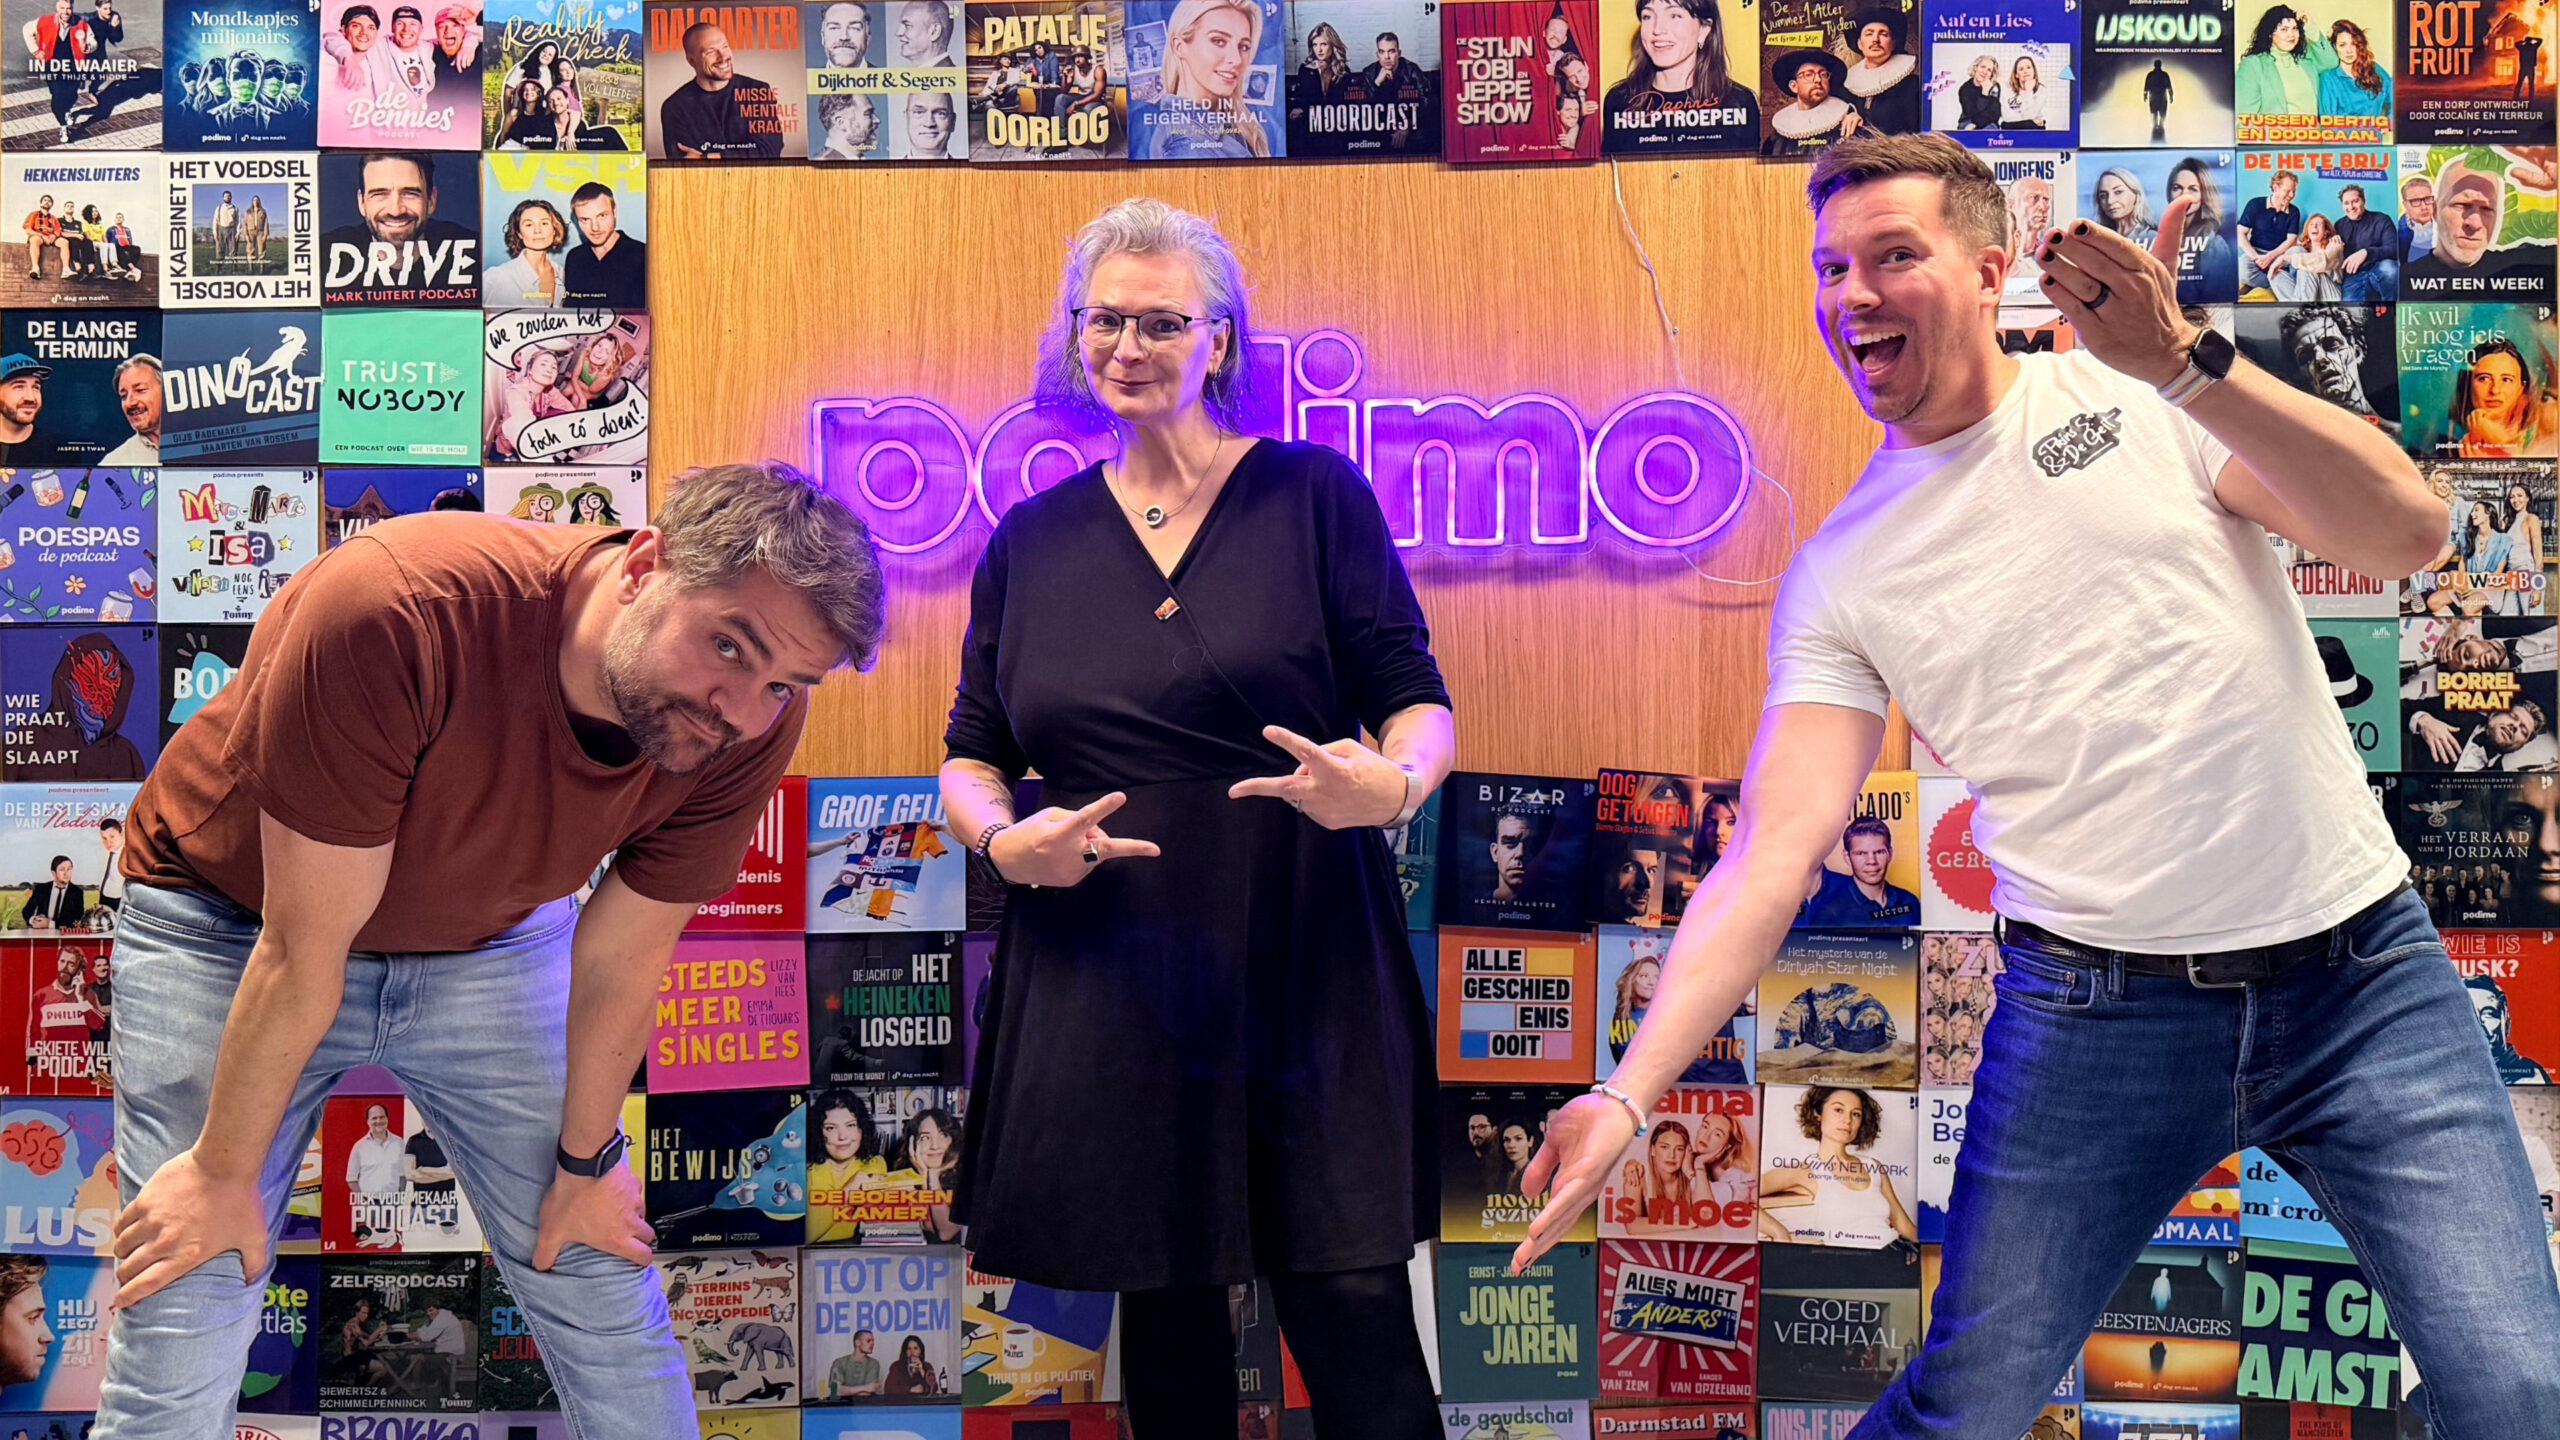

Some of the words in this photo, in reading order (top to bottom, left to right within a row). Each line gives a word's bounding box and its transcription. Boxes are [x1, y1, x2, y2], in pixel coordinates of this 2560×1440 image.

[191, 11, 299, 29] Mondkapjes
[503, 2, 606, 51] Reality
[2409, 1, 2481, 47] ROT
[201, 28, 290, 45] miljonairs
[984, 14, 1107, 55] PATATJE
[1933, 30, 1975, 41] pakken
[1978, 29, 2006, 39] door
[1467, 37, 1533, 58] STIJN
[28, 59, 47, 72] IN
[50, 59, 71, 72] DE
[74, 59, 138, 72] WAAIER
[1457, 60, 1514, 81] TOBI
[2409, 48, 2475, 76] FRUIT
[818, 73, 877, 92] Dijkhoff
[882, 73, 898, 88] &
[900, 72, 956, 91] Segers
[1456, 80, 1531, 102] JEPPE
[734, 88, 778, 101] MISSIE
[740, 104, 797, 118] MENTALE
[1172, 98, 1213, 111] HELD
[1219, 98, 1233, 110] IN
[1456, 102, 1532, 124] SHOW
[2422, 101, 2440, 109] EEN
[2444, 100, 2470, 109] DORP
[2473, 100, 2530, 109] ONTWRICHT
[1144, 112, 1191, 125] EIGEN
[1196, 112, 1267, 124] VERHAAL
[1309, 103, 1419, 132] MOORDCAST
[1614, 108, 1747, 129] HULPTROEPEN
[2238, 114, 2317, 127] TUSSEN
[2320, 115, 2389, 128] DERTIG
[2409, 111, 2436, 120] DOOR
[2483, 111, 2497, 119] EN
[2500, 111, 2543, 120] TERREUR
[749, 120, 798, 134] KRACHT
[986, 105, 1109, 147] OORLOG
[202, 134, 231, 143] podimo
[1190, 141, 1223, 150] podimo
[1348, 140, 1381, 149] podimo
[170, 160, 210, 178] HET
[215, 160, 311, 178] VOEDSEL
[2244, 153, 2271, 169] DE
[2277, 152, 2334, 169] HETE
[2340, 152, 2391, 170] BRIJ
[24, 167, 140, 182] HEKKENSLUITERS
[325, 239, 476, 287] DRIVE
[2410, 278, 2447, 291] WAT
[2452, 278, 2485, 290] EEN
[2490, 277, 2544, 290] WEEK!
[326, 291, 363, 303] MARK
[366, 290, 416, 302] TUITERT
[419, 288, 477, 301] PODCAST
[27, 322, 58, 338] DE
[62, 321, 137, 338] LANGE
[35, 341, 128, 359] TERMIJN
[2401, 346, 2477, 366] vragen
[173, 433, 192, 443] GIJS
[195, 425, 247, 441] RADEMAKER
[201, 441, 242, 454] MAARTEN
[245, 438, 262, 447] VAN
[263, 432, 299, 445] ROSSEM
[19, 526, 140, 547] POESPAS
[62, 606, 94, 615] podimo
[223, 610, 254, 621] Tonny
[2437, 671, 2521, 692] BORREL
[5, 694, 40, 709] WIE
[2444, 691, 2515, 712] PRAAT
[5, 731, 35, 745] DIE
[5, 750, 79, 765] SLAAPT
[1599, 772, 1637, 797] OOG
[1479, 784, 1566, 806] BIZAR
[1596, 798, 1690, 827] GETUIGEN
[15, 818, 40, 829] VAN
[2421, 835, 2442, 844] HET
[2445, 831, 2530, 844] VERRAAD
[2448, 846, 2529, 860] JORDAAN
[1499, 911, 1531, 920] podimo
[2463, 911, 2497, 920] podimo
[912, 953, 952, 983] HET
[1465, 950, 1521, 971] ALLE
[1464, 978, 1571, 1000] GESCHIED
[843, 985, 951, 1016] HEINEKEN
[1519, 1007, 1569, 1028] ENIS
[861, 1016, 952, 1048] LOSGELD
[1492, 1035, 1541, 1057] OOIT
[651, 1128, 681, 1150] HET
[651, 1149, 752, 1182] BEWIJS
[1773, 1156, 1800, 1169] OLD
[1840, 1161, 1909, 1178] NETWORK
[2246, 1161, 2278, 1183] de
[809, 1189, 846, 1206] DE
[849, 1189, 954, 1206] BOEKEN
[833, 1206, 930, 1222] KAMER
[692, 1233, 722, 1243] podimo
[865, 1227, 898, 1237] podimo
[1795, 1229, 1825, 1238] podimo
[331, 1275, 468, 1289] ZELFSPODCAST
[816, 1257, 888, 1294] TOT
[899, 1256, 950, 1292] OP
[694, 1294, 743, 1307] DIEREN
[1460, 1285, 1555, 1326] JONGE
[2242, 1271, 2313, 1333] DE
[816, 1302, 849, 1334] DE
[857, 1299, 951, 1332] BODEM
[1800, 1298, 1880, 1323] GOED
[1483, 1324, 1578, 1365] JAREN
[1774, 1321, 1904, 1350] VERHAAL
[2236, 1343, 2399, 1410] AMST
[320, 1387, 379, 1396] SIEWERTSZ
[319, 1398, 426, 1408] SCHIMMELPENNINCK
[440, 1398, 473, 1408] Tonny
[1600, 1413, 1706, 1435] Darmstad
[1712, 1412, 1746, 1430] FM
